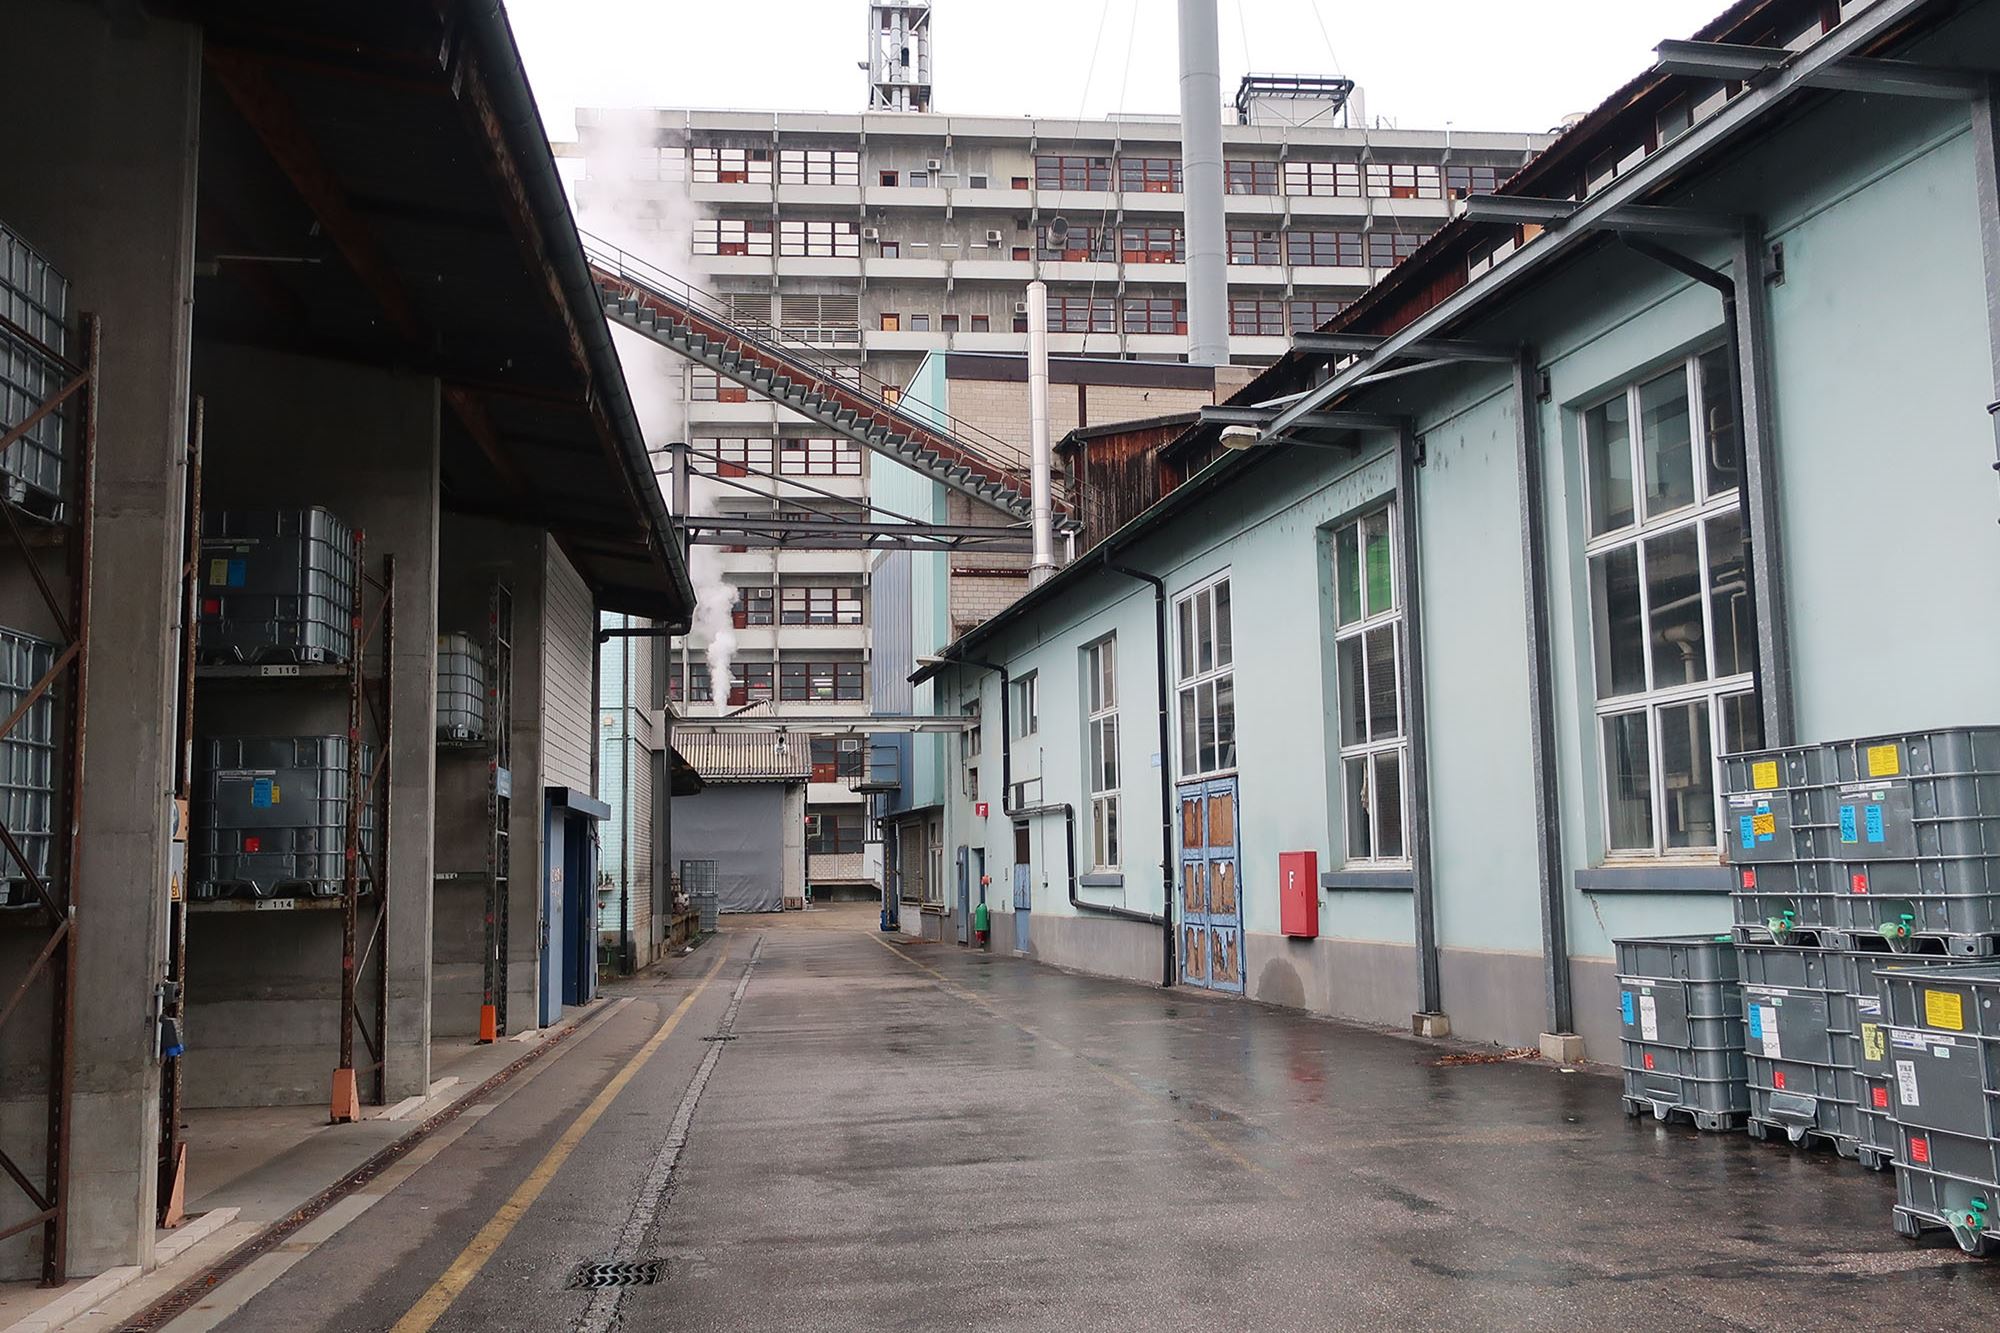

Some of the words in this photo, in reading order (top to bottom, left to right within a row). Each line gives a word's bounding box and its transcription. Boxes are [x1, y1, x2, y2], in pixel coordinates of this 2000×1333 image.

[263, 667, 269, 675] 2
[279, 666, 297, 675] 116
[979, 805, 986, 816] F
[1288, 870, 1295, 890] F
[257, 901, 263, 909] 2
[273, 901, 292, 909] 114
